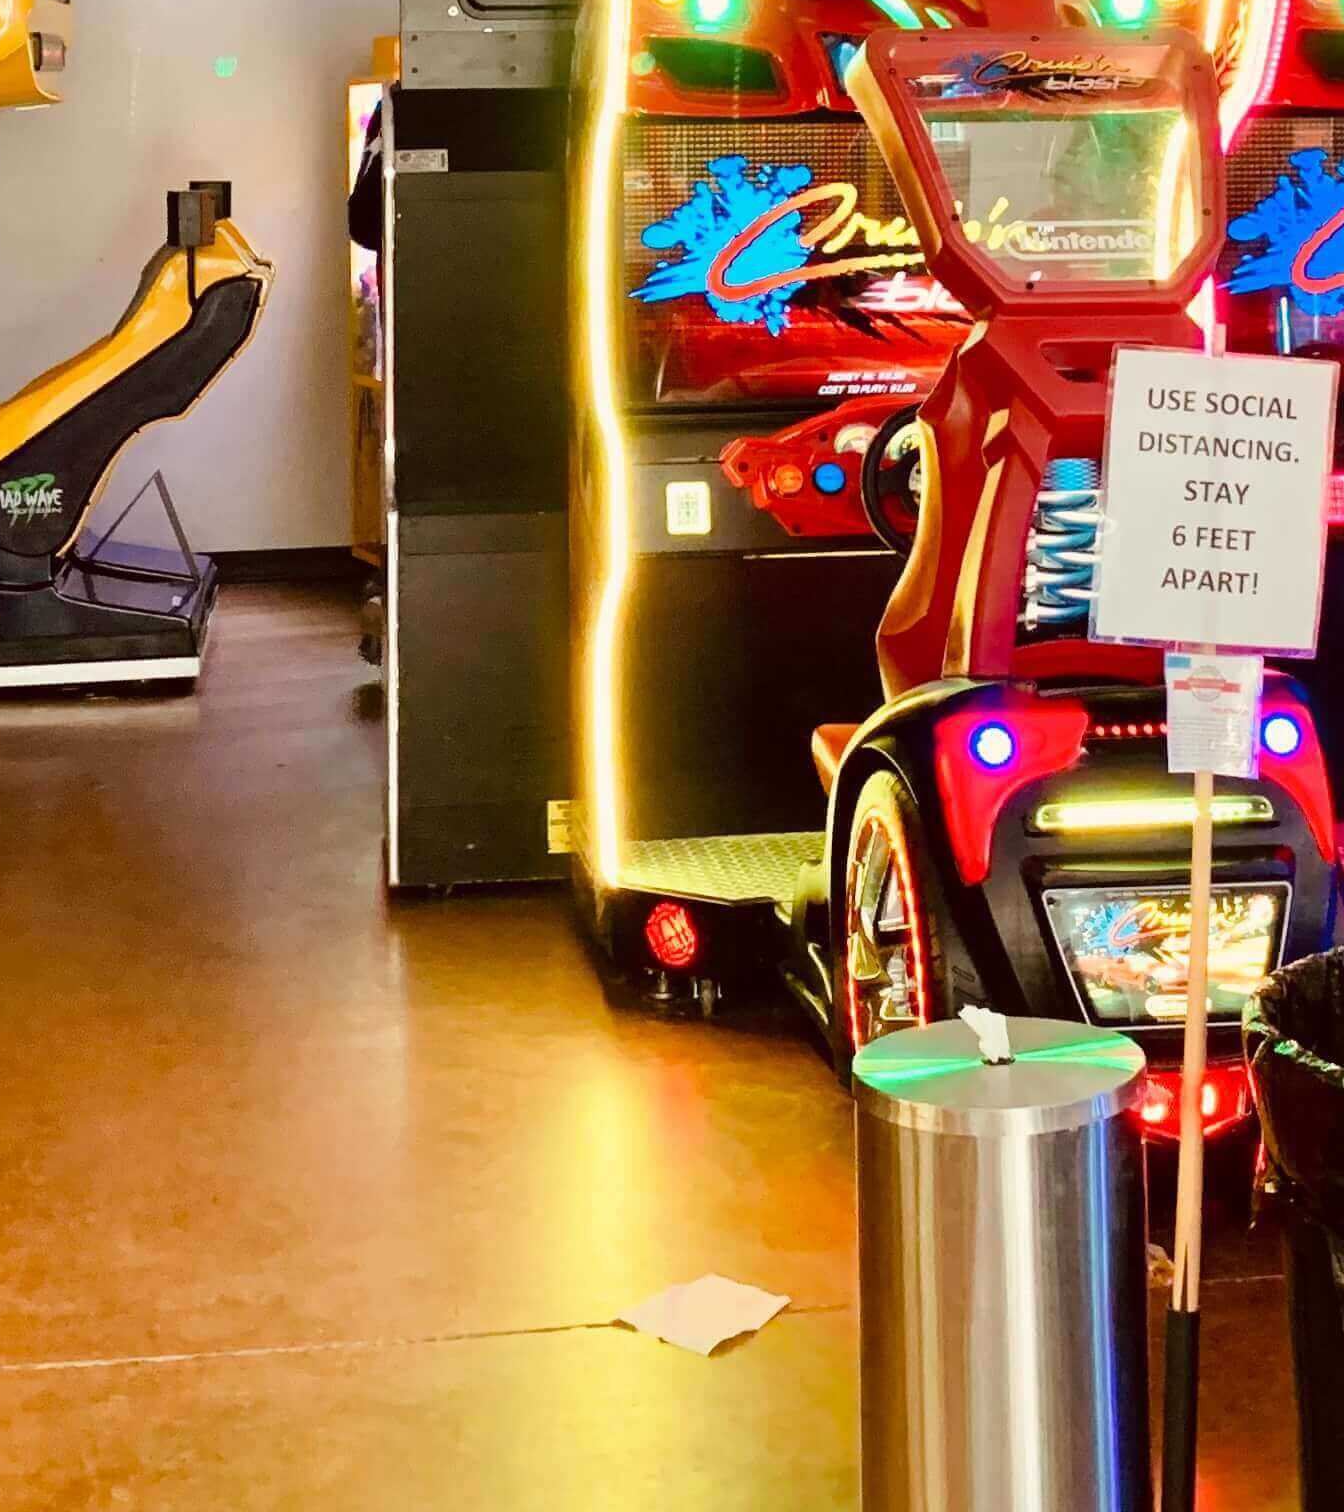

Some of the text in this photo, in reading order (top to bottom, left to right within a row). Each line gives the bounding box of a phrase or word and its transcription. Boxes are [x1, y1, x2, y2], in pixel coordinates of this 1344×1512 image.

[1041, 76, 1121, 90] blast
[1147, 387, 1298, 420] USE SOCIAL
[1138, 430, 1300, 464] DISTANCING.
[24, 488, 63, 507] WAVE
[1183, 479, 1250, 505] STAY
[1172, 524, 1256, 551] 6 FEET
[1160, 566, 1260, 595] APART!
